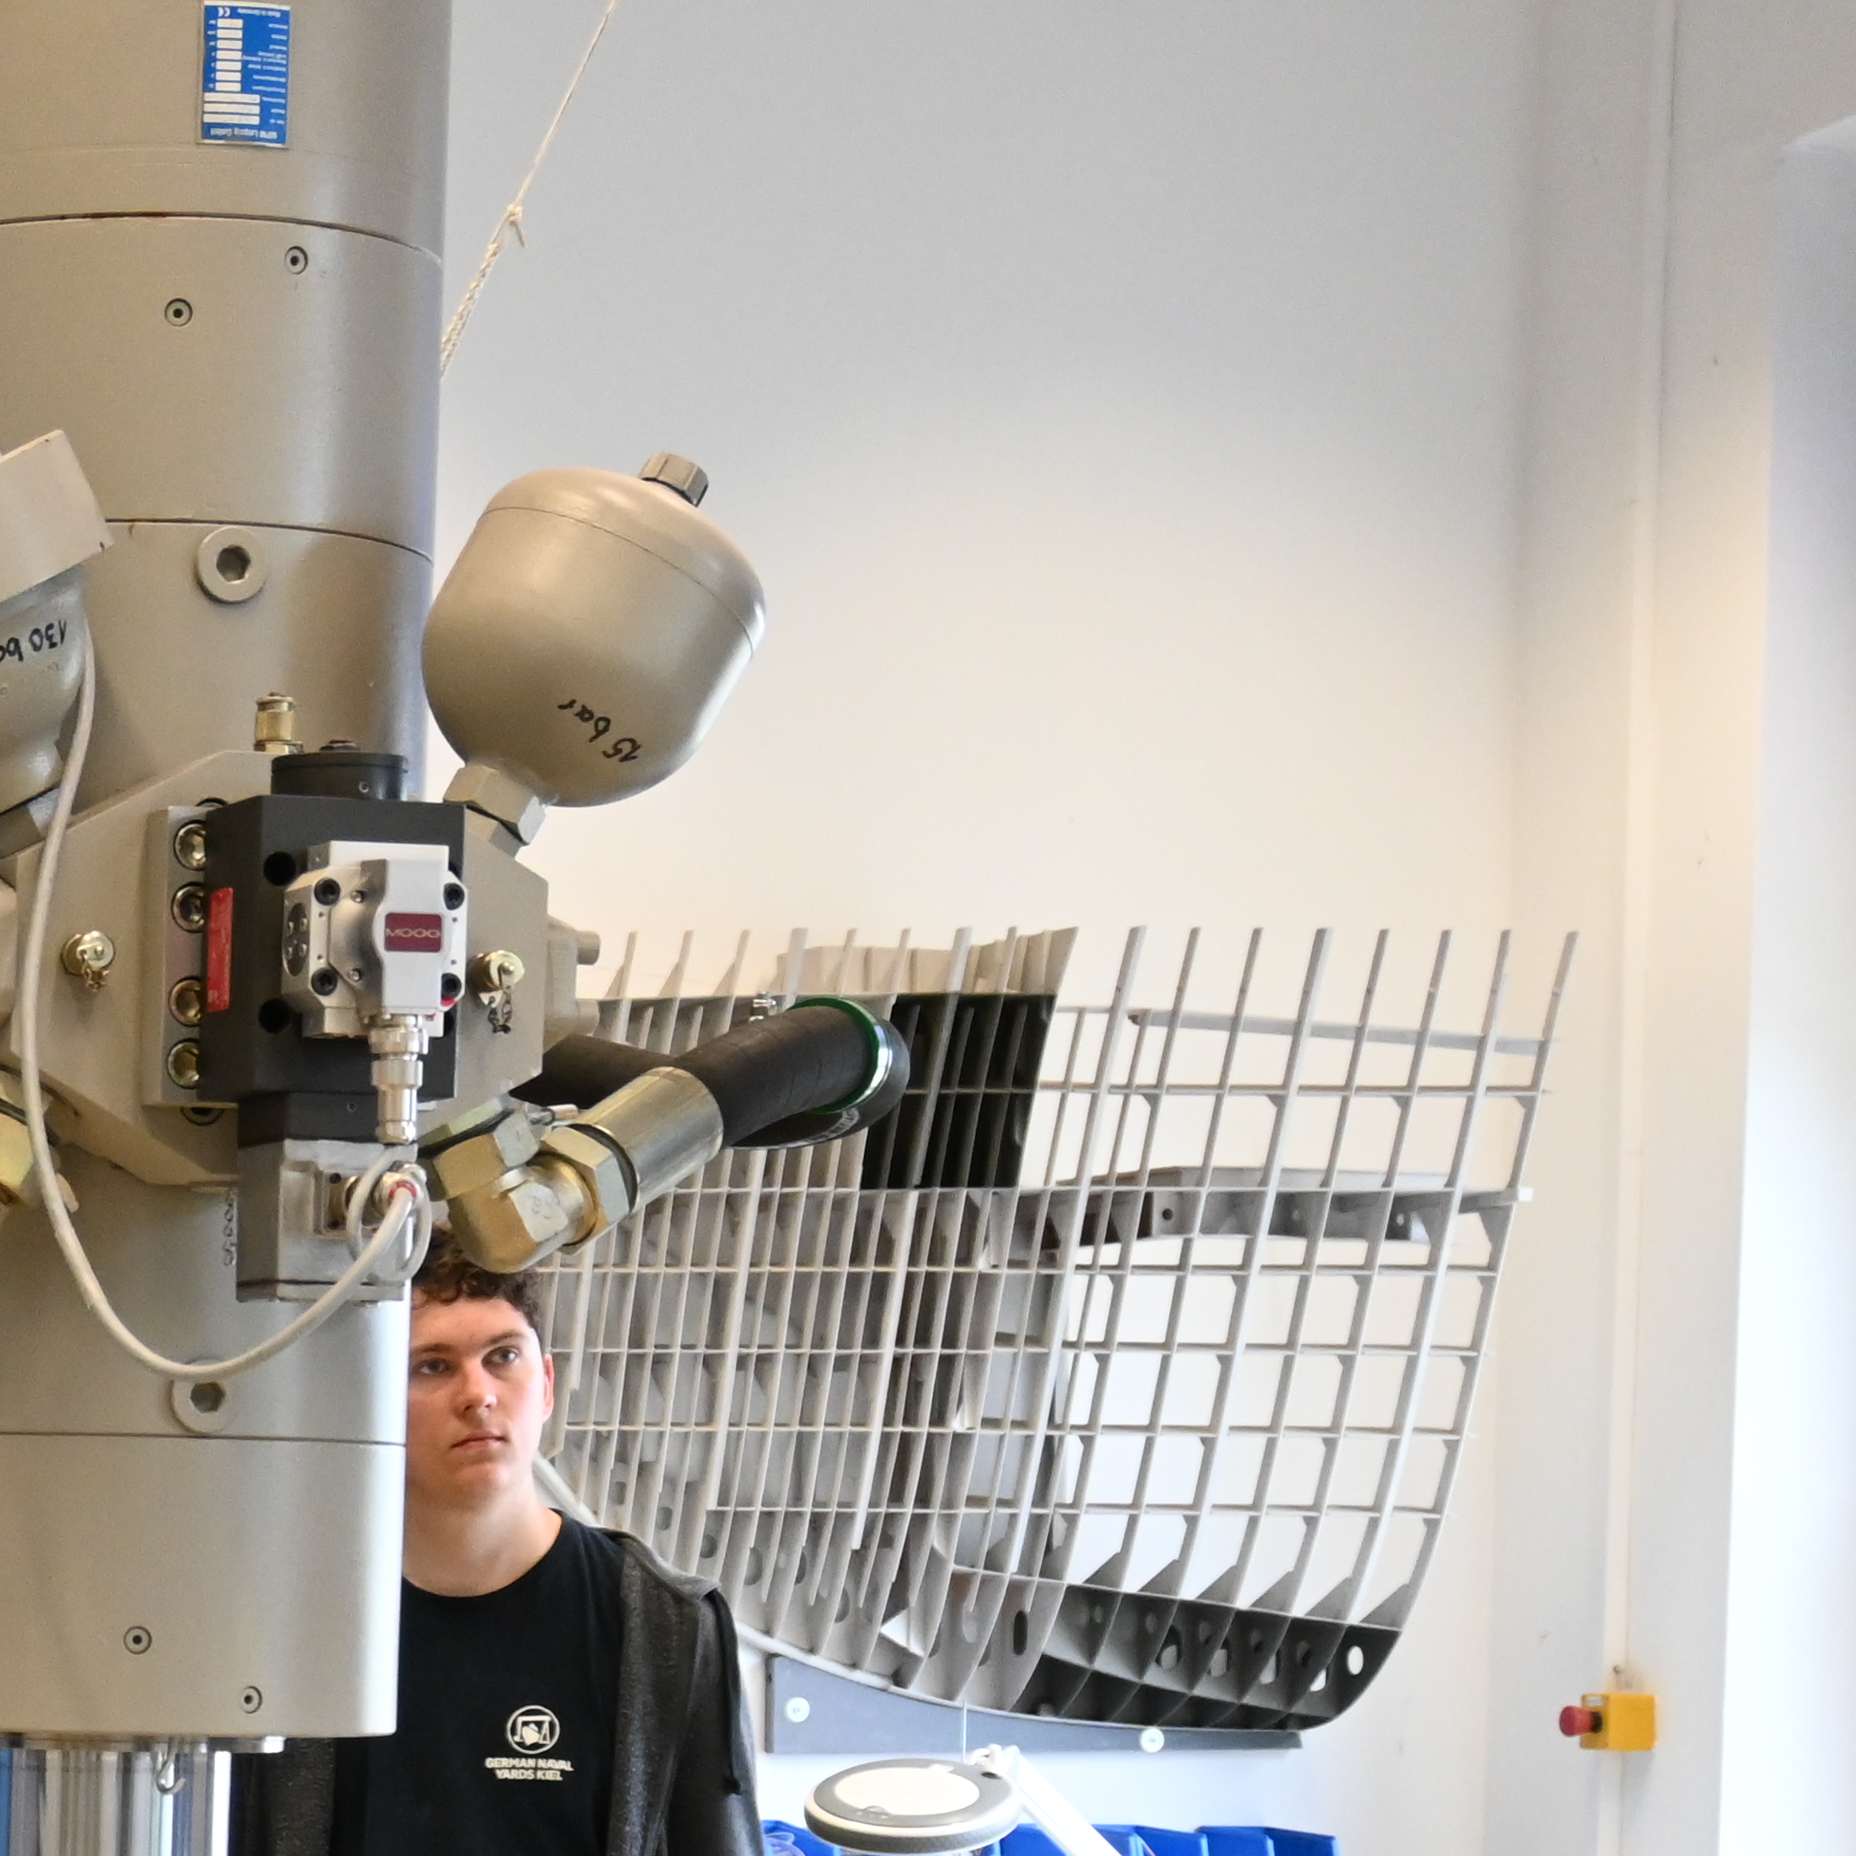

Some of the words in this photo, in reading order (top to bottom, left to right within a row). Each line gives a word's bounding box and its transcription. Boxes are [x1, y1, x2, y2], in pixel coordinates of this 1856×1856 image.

[28, 618, 67, 653] 130
[557, 699, 611, 743] bar
[601, 737, 641, 763] 15
[385, 927, 441, 938] MOOG
[485, 1757, 536, 1769] GERMAN
[537, 1758, 574, 1771] NAVAL
[494, 1769, 535, 1780] YARDS
[536, 1770, 563, 1781] KIEL
